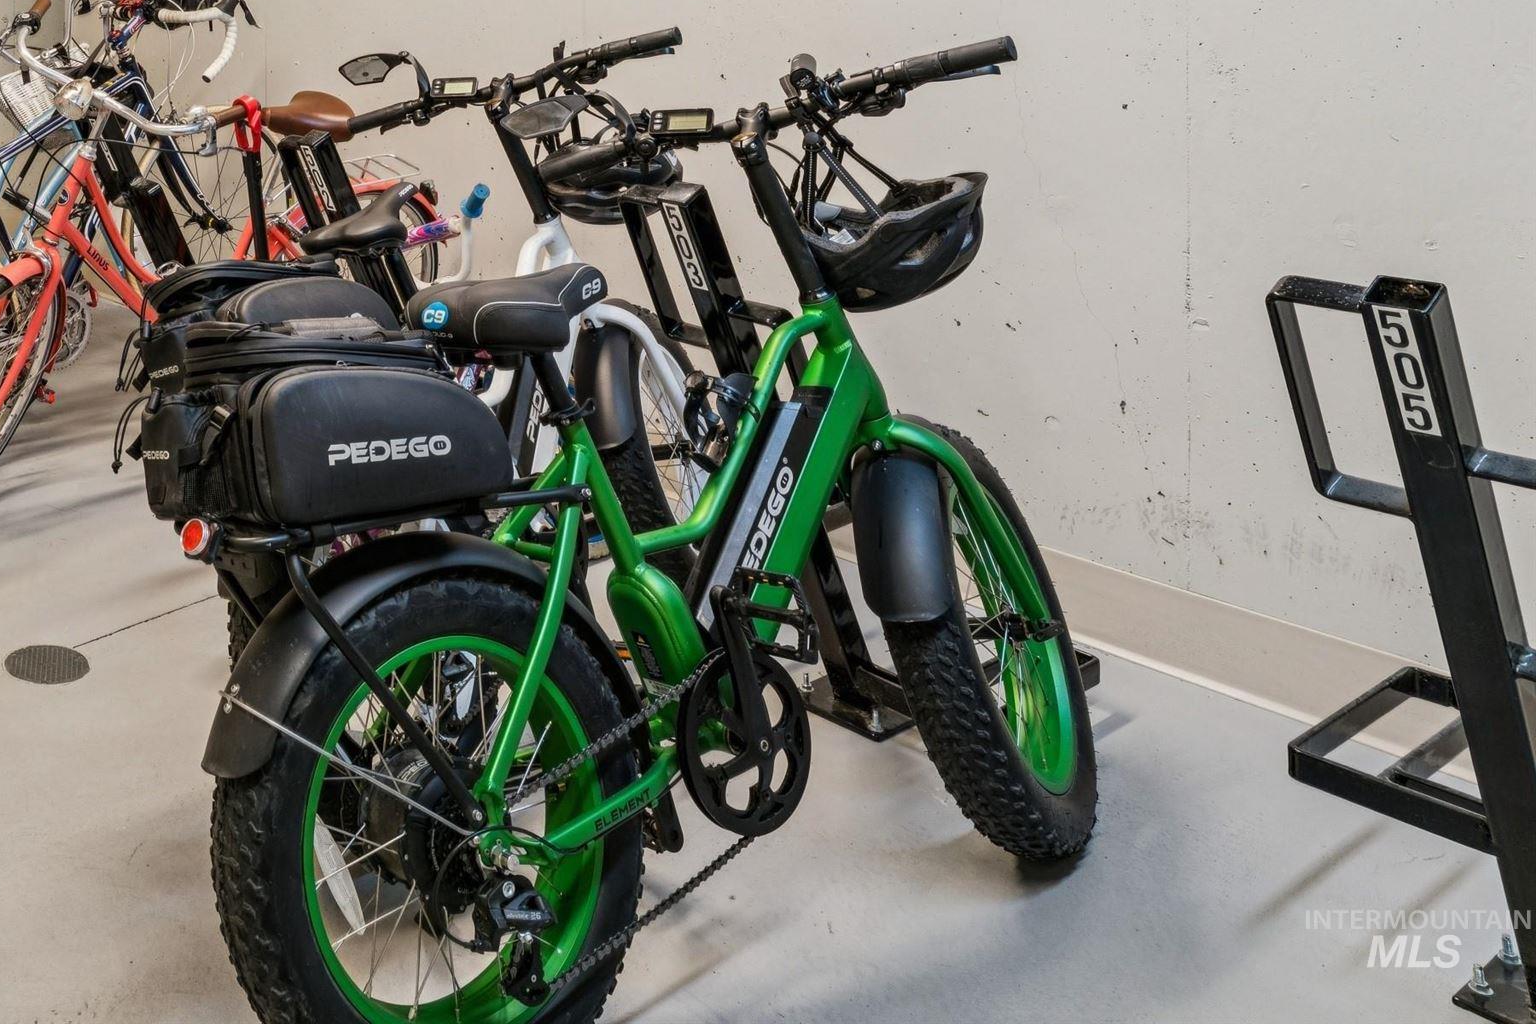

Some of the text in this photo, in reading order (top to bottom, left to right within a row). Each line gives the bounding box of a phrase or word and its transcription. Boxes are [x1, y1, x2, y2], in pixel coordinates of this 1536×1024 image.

[302, 146, 335, 210] 502
[665, 205, 704, 287] 503
[423, 309, 446, 324] C9
[148, 364, 180, 379] PEDEGO
[1377, 309, 1433, 431] 505
[143, 450, 170, 460] PEDEGO
[327, 434, 452, 467] PEDEGO
[741, 465, 794, 571] EDEGO
[594, 788, 651, 832] ELEMENT
